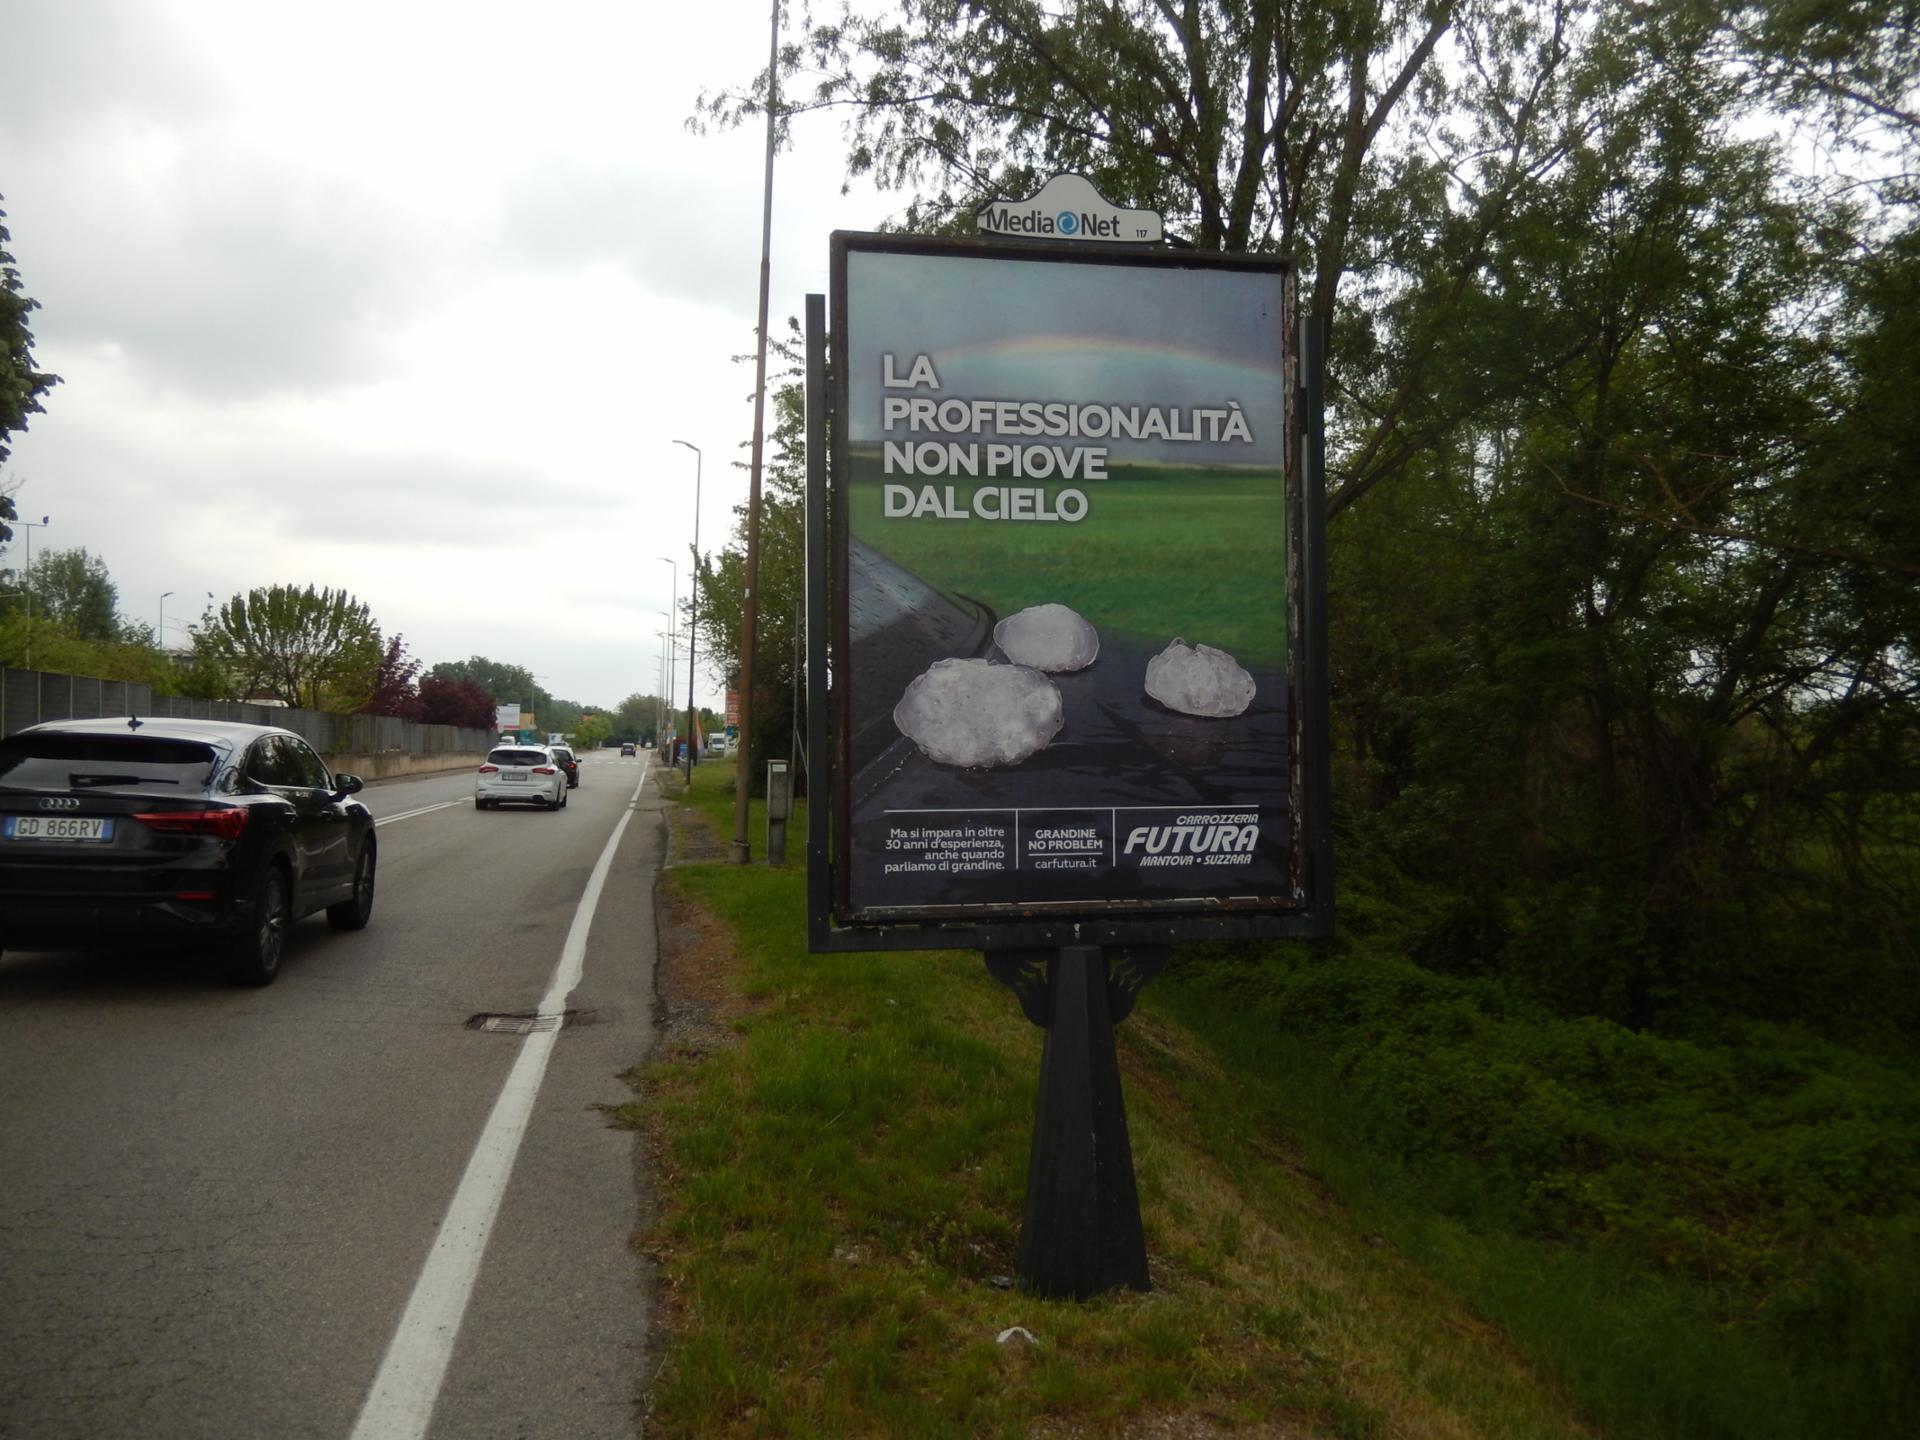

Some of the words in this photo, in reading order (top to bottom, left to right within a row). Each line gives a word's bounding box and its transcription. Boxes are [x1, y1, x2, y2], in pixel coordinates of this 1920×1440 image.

[986, 208, 1054, 234] Media
[1081, 213, 1120, 238] Net
[1136, 229, 1148, 239] 117
[883, 354, 939, 389] LA
[883, 398, 1253, 443] PROFESSIONALITÀ
[883, 441, 978, 476] NON
[987, 444, 1108, 480] PIOVE
[883, 485, 969, 519] DAL
[973, 487, 1088, 522] CIELO
[1176, 814, 1259, 826] CARROZZERIA
[18, 819, 40, 835] GD
[46, 820, 101, 837] 866RV
[890, 828, 908, 839] Ma
[910, 828, 920, 838] si
[921, 827, 962, 841] impara
[965, 827, 975, 838] in
[977, 827, 1005, 838] oltre
[1035, 829, 1097, 839] GRANDINE
[885, 839, 901, 850] 30
[903, 839, 929, 849] anni
[930, 838, 1004, 851] d'esperienza,
[1028, 840, 1046, 850] NO
[1048, 839, 1103, 850] PROBLEM
[1123, 825, 1260, 854] FUTURA
[924, 850, 959, 860] anche
[962, 849, 1005, 863] quando
[1139, 855, 1194, 867] MANTOVA
[1203, 854, 1252, 866] SUZZARA
[884, 861, 937, 874] parliamo
[938, 861, 950, 871] di
[951, 861, 1005, 874] grandine.
[1035, 858, 1097, 869] carfutura.it
